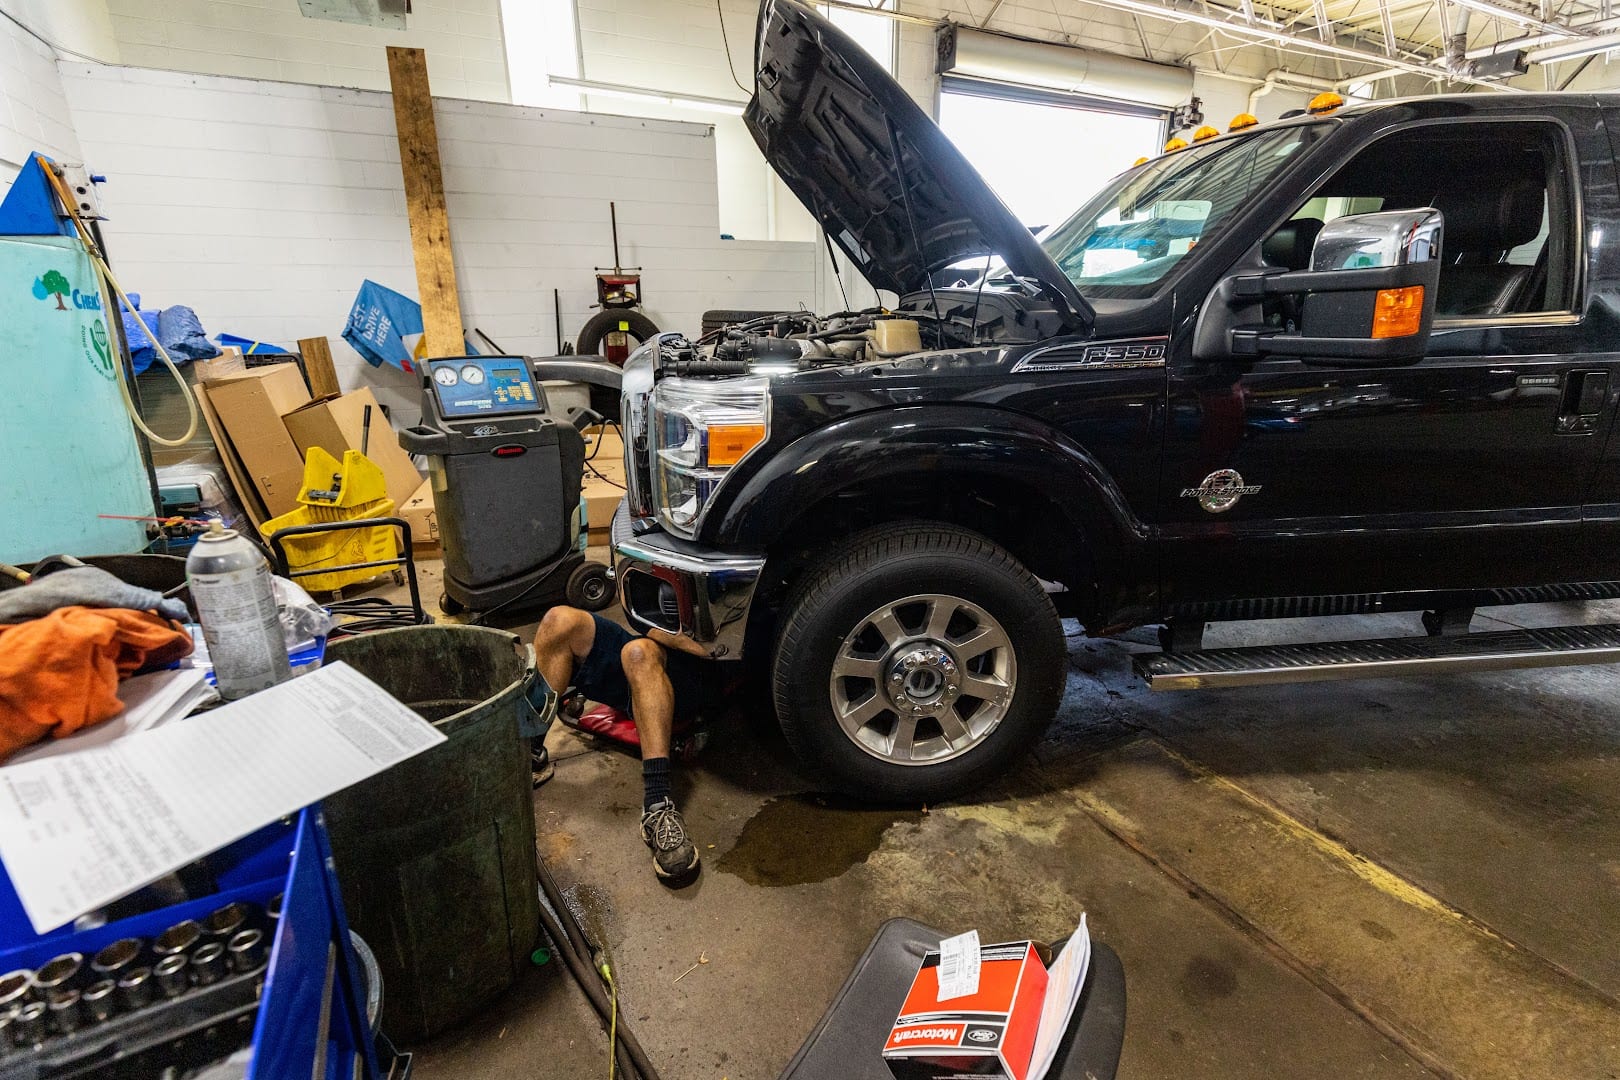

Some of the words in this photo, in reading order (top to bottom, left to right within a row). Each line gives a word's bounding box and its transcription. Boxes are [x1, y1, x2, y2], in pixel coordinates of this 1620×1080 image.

[353, 303, 367, 329] EST-
[362, 305, 380, 341] DRIVE
[375, 315, 392, 347] HERE
[893, 1028, 958, 1043] Motorcraft
[970, 1030, 996, 1042] Ford
